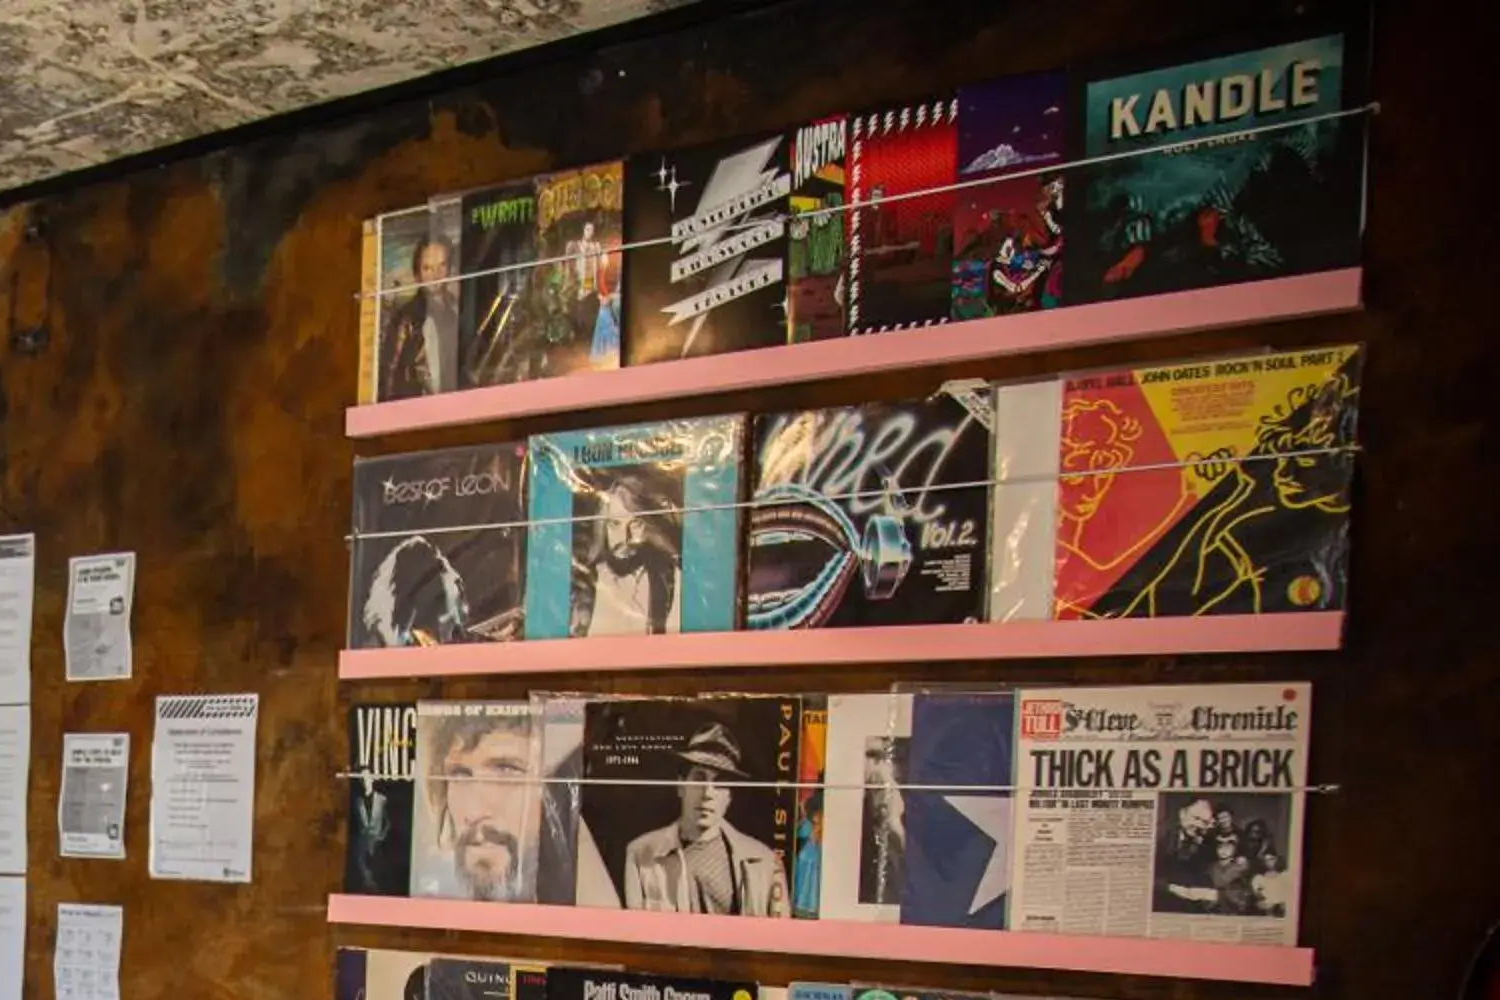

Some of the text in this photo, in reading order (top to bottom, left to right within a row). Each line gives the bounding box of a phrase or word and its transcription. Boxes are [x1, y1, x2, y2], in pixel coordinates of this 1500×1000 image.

[1110, 59, 1322, 139] KANDLE
[1141, 369, 1172, 384] JOHN
[1173, 365, 1211, 381] OATES
[1265, 356, 1296, 371] SOUL
[1301, 351, 1334, 367] PART
[1029, 748, 1295, 788] THICK AS A BRICK
